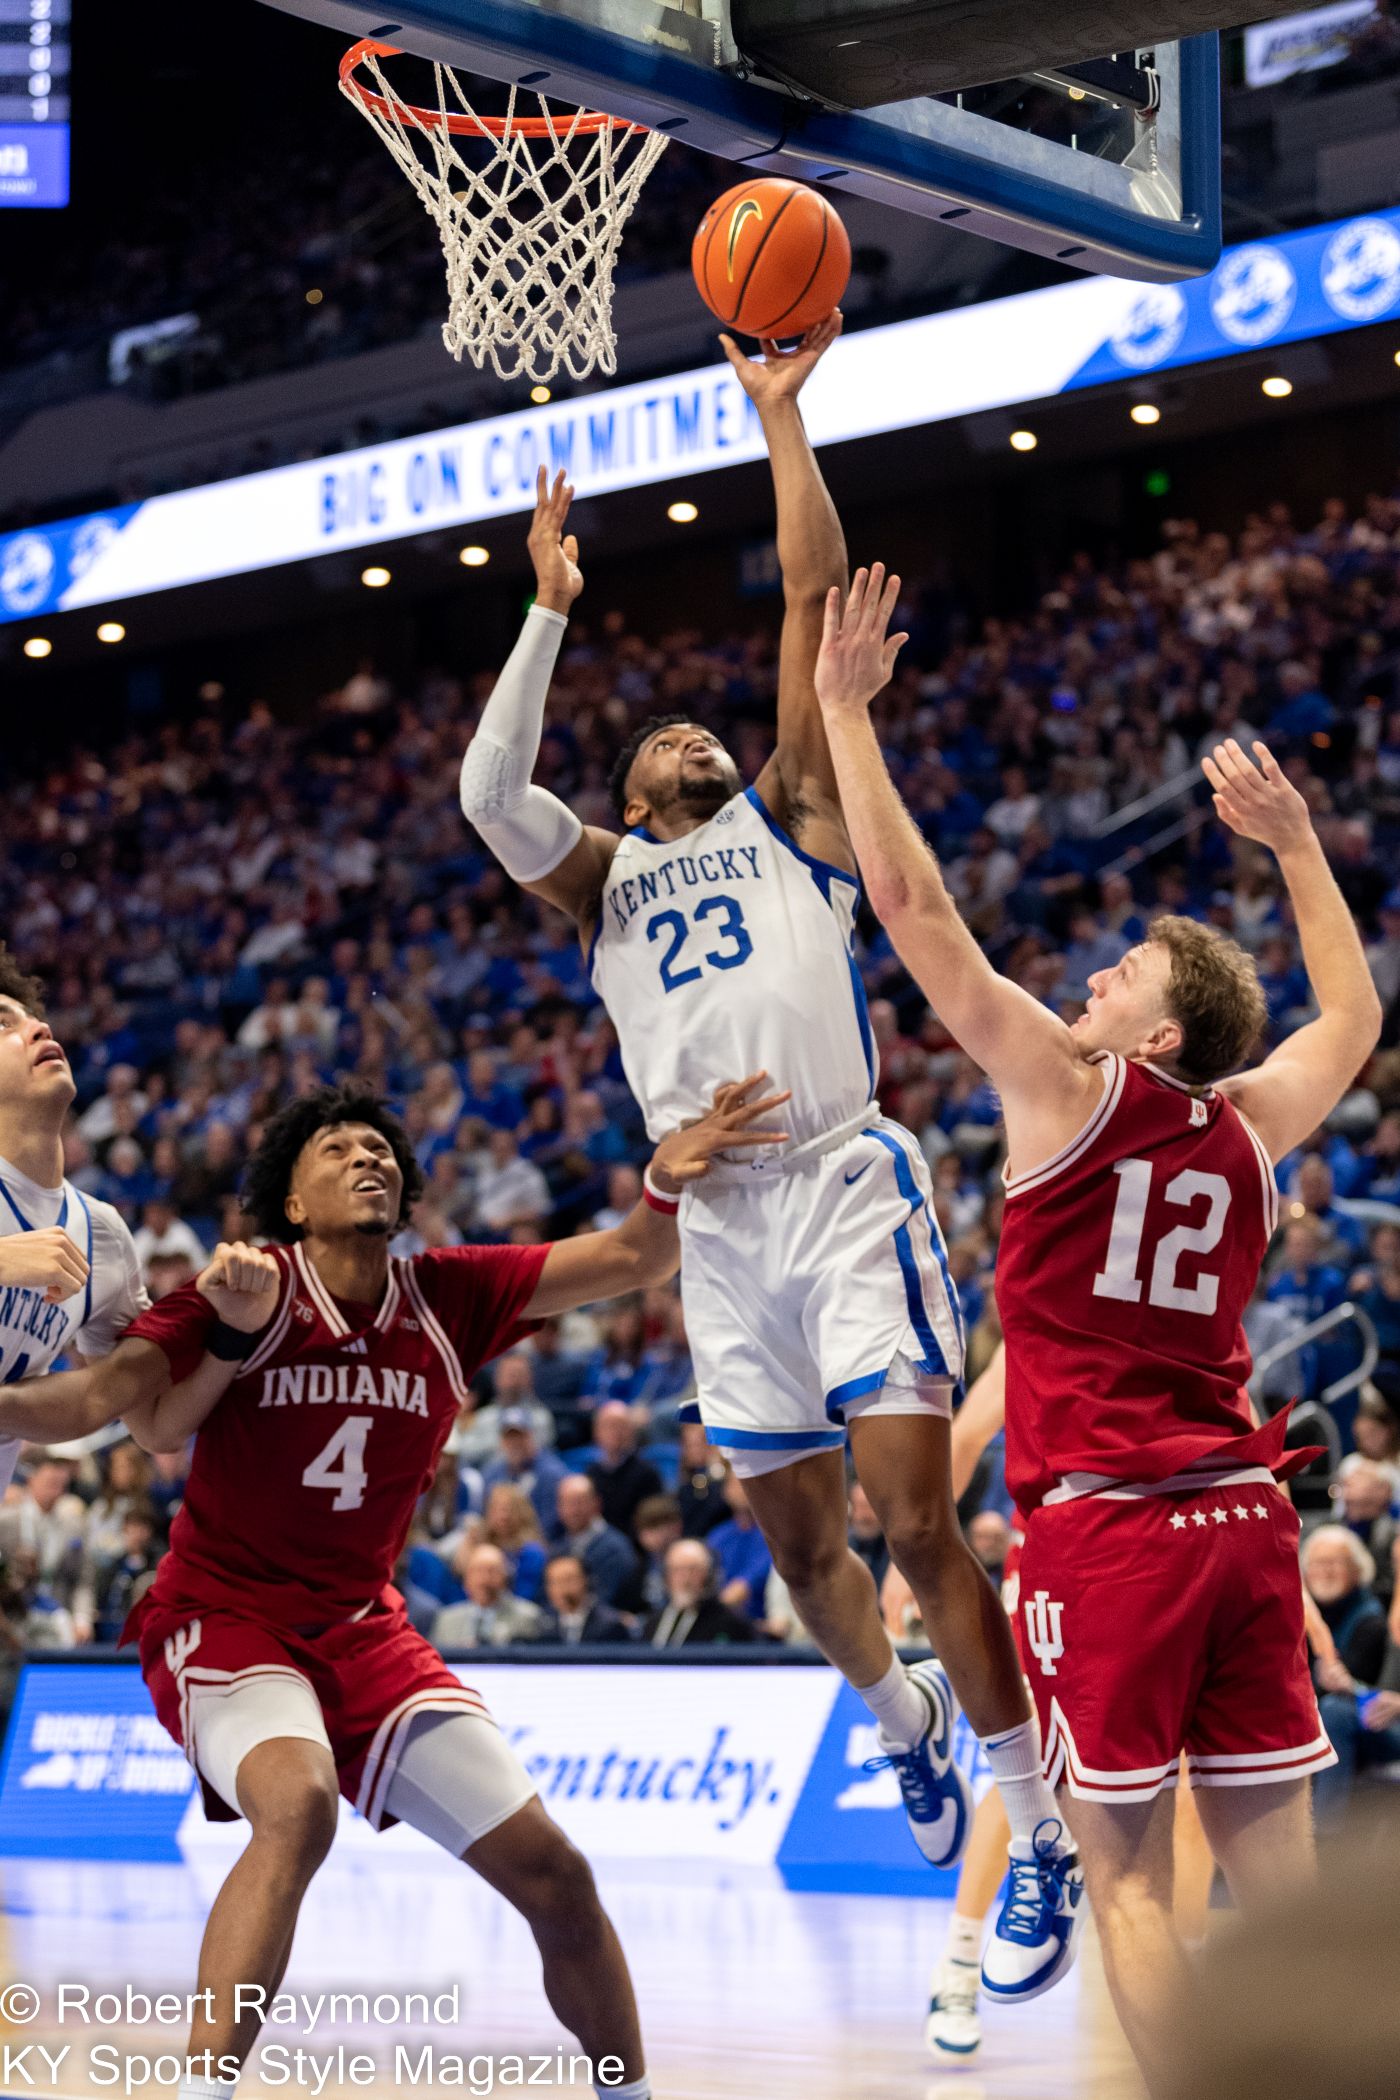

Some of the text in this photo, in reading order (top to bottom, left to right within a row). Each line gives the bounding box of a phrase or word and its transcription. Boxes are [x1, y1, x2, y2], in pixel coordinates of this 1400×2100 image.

[318, 381, 765, 535] BIG ON COMMITMEN
[608, 846, 762, 933] KENTUCKY
[646, 894, 754, 994] 23
[1092, 1157, 1232, 1316] 12
[258, 1364, 430, 1418] INDIANA
[302, 1416, 374, 1511] 4
[500, 1723, 779, 1831] entucky.
